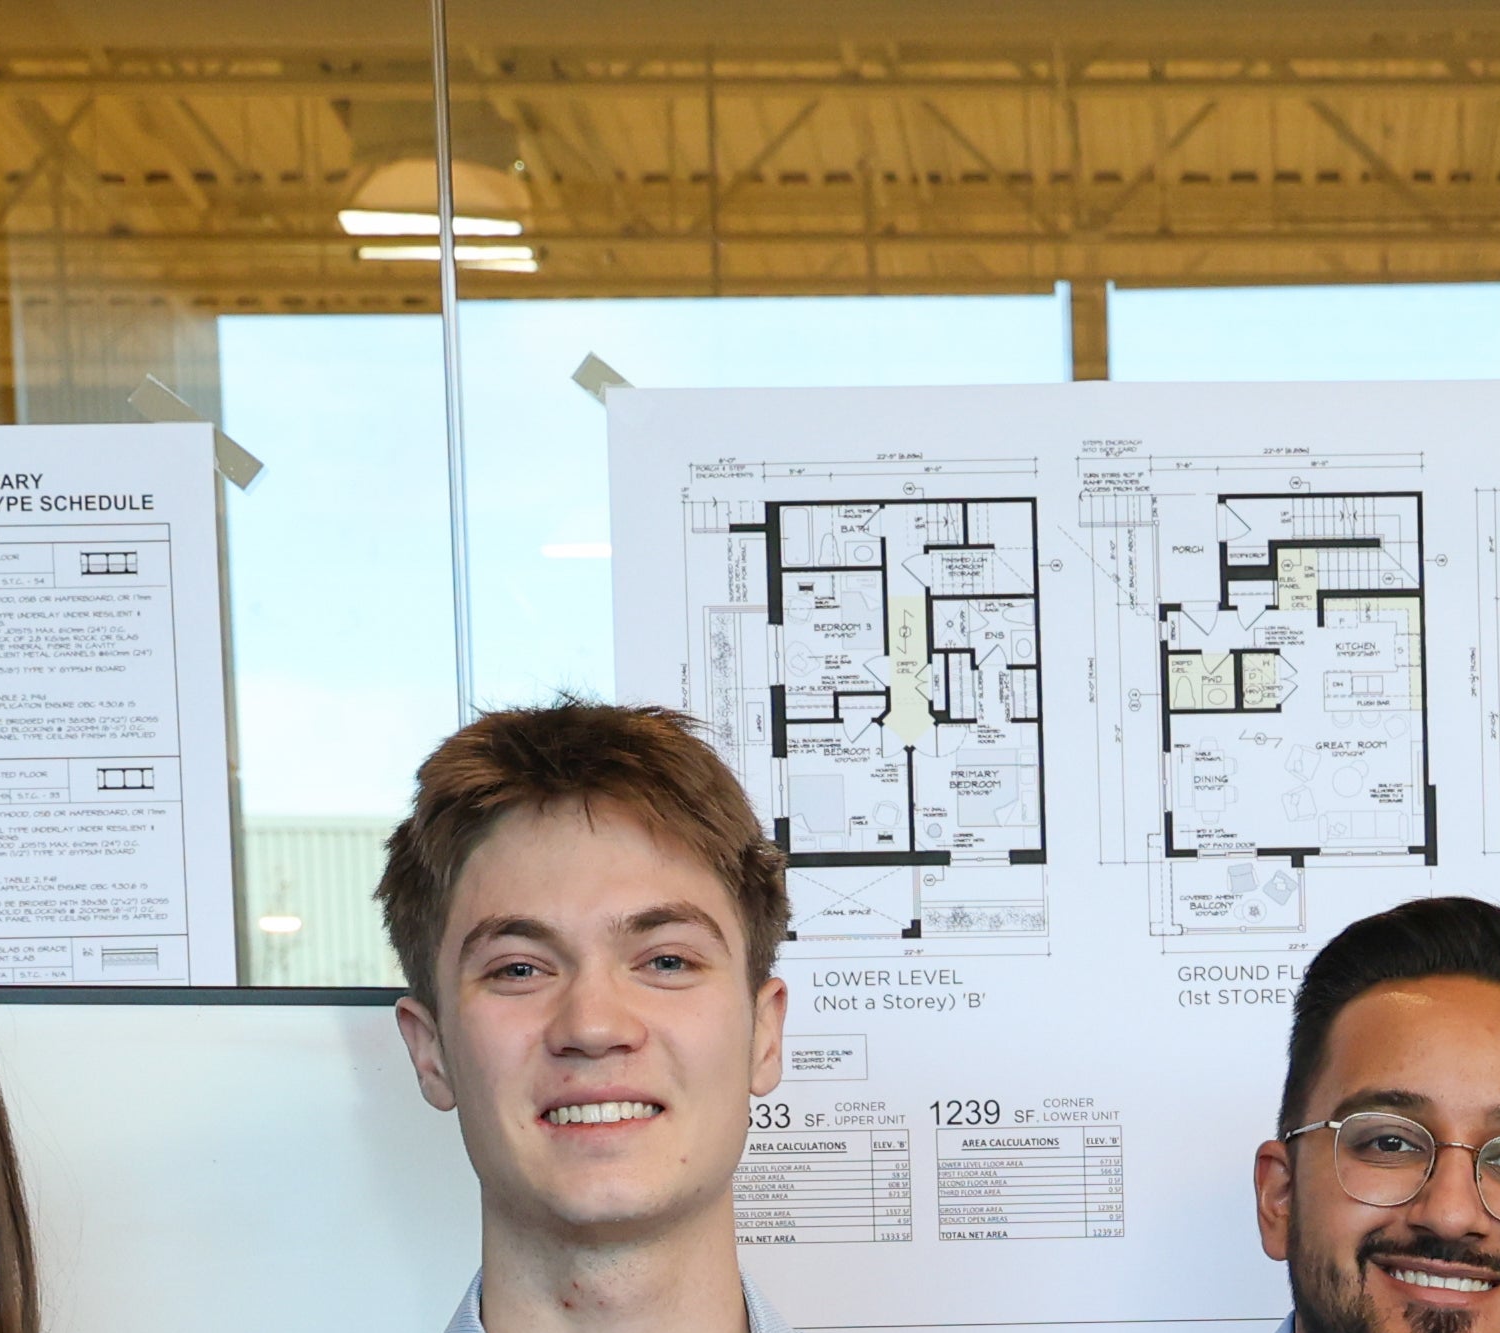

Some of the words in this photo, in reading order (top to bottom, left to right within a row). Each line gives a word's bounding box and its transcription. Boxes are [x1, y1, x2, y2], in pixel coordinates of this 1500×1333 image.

[40, 495, 154, 511] SCHEDULE
[814, 623, 861, 631] BEDROOM
[865, 623, 872, 631] 3
[1336, 642, 1376, 650] KITCHEN
[1315, 741, 1352, 750] GREAT
[1357, 741, 1388, 749] ROOM
[1194, 775, 1229, 784] DINING
[1190, 901, 1234, 910] BALCONY
[813, 970, 891, 987] LOWER
[898, 969, 964, 986] LEVEL
[1178, 966, 1270, 982] GROUND
[814, 994, 858, 1013] (Not
[866, 999, 876, 1010] a
[883, 993, 956, 1012] Storey)
[963, 992, 987, 1009] 'B'
[1178, 989, 1213, 1008] (1st
[1043, 1098, 1094, 1109] CORNER
[930, 1100, 1001, 1126] 1239
[1043, 1111, 1088, 1122] LOWER
[1091, 1111, 1120, 1121] UNIT
[962, 1138, 986, 1148] AREA
[989, 1137, 1060, 1147] CALCULATIONS
